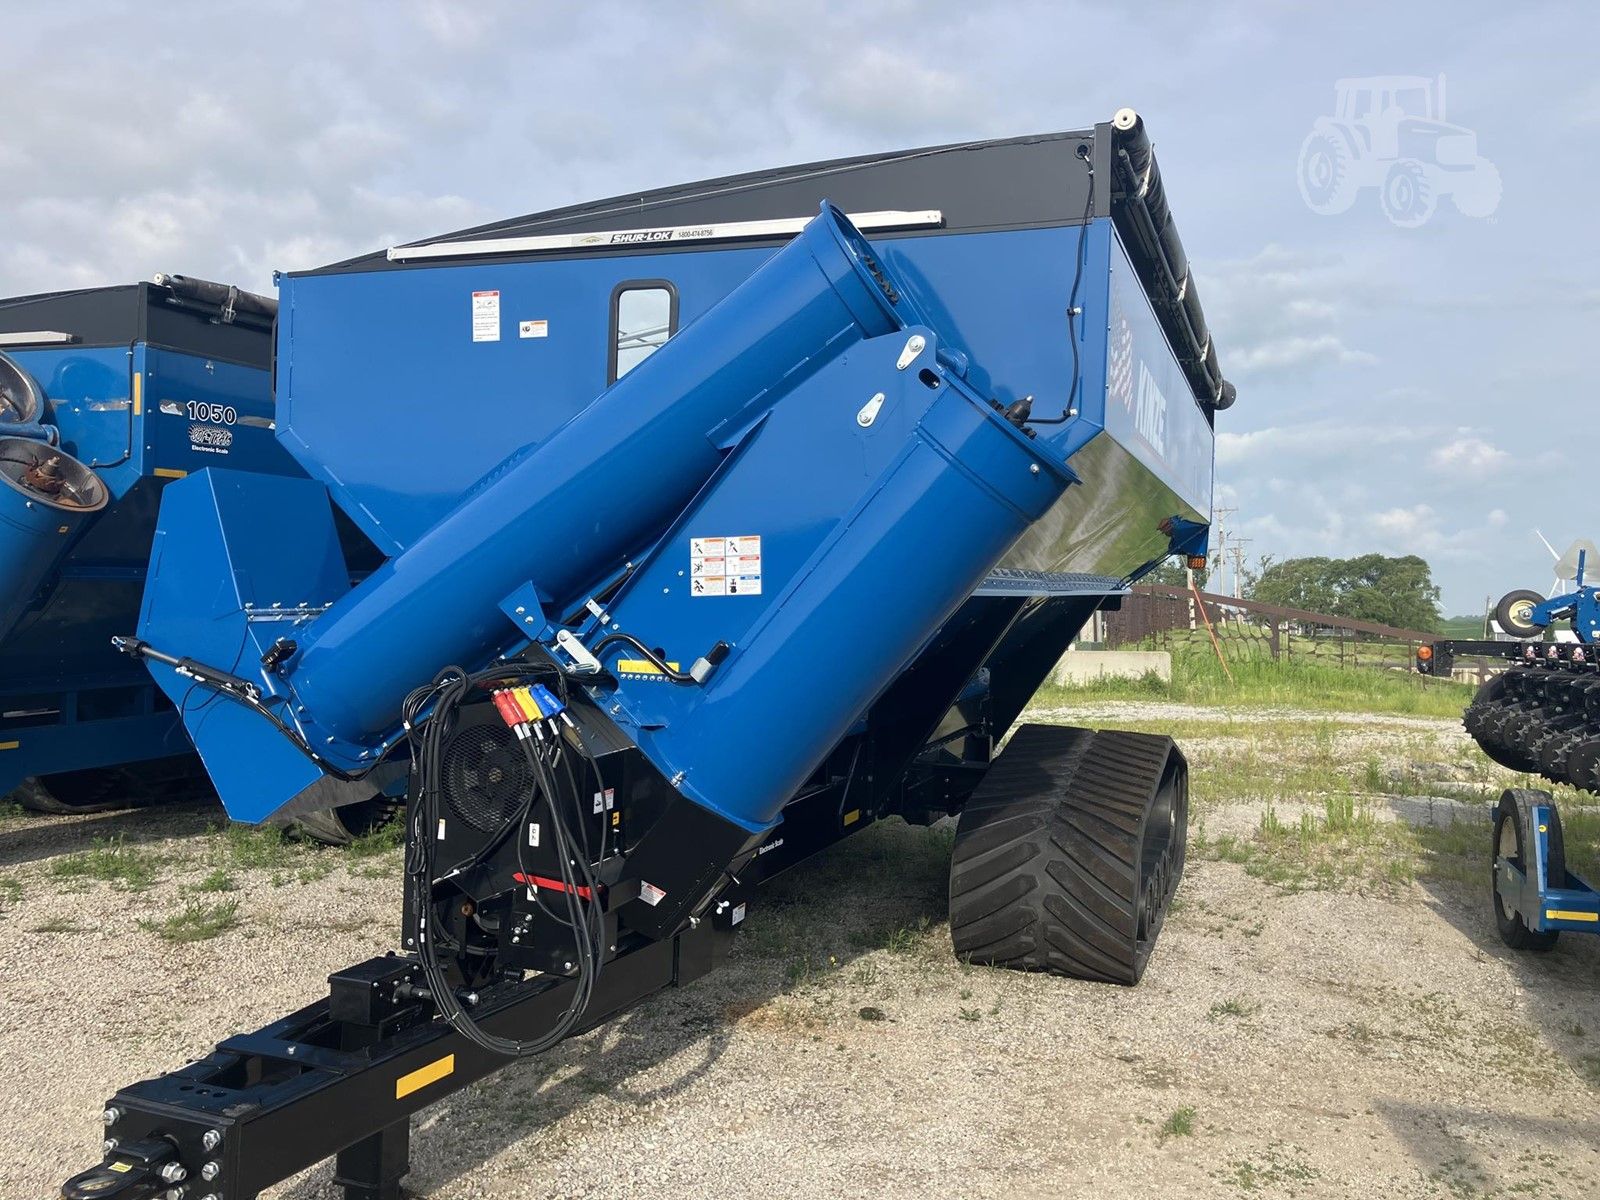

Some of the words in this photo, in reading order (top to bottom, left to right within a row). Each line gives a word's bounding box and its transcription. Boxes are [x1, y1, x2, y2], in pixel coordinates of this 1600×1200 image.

[612, 231, 671, 243] SHUR-LOK
[187, 400, 237, 425] 1050
[191, 444, 215, 453] Electronic
